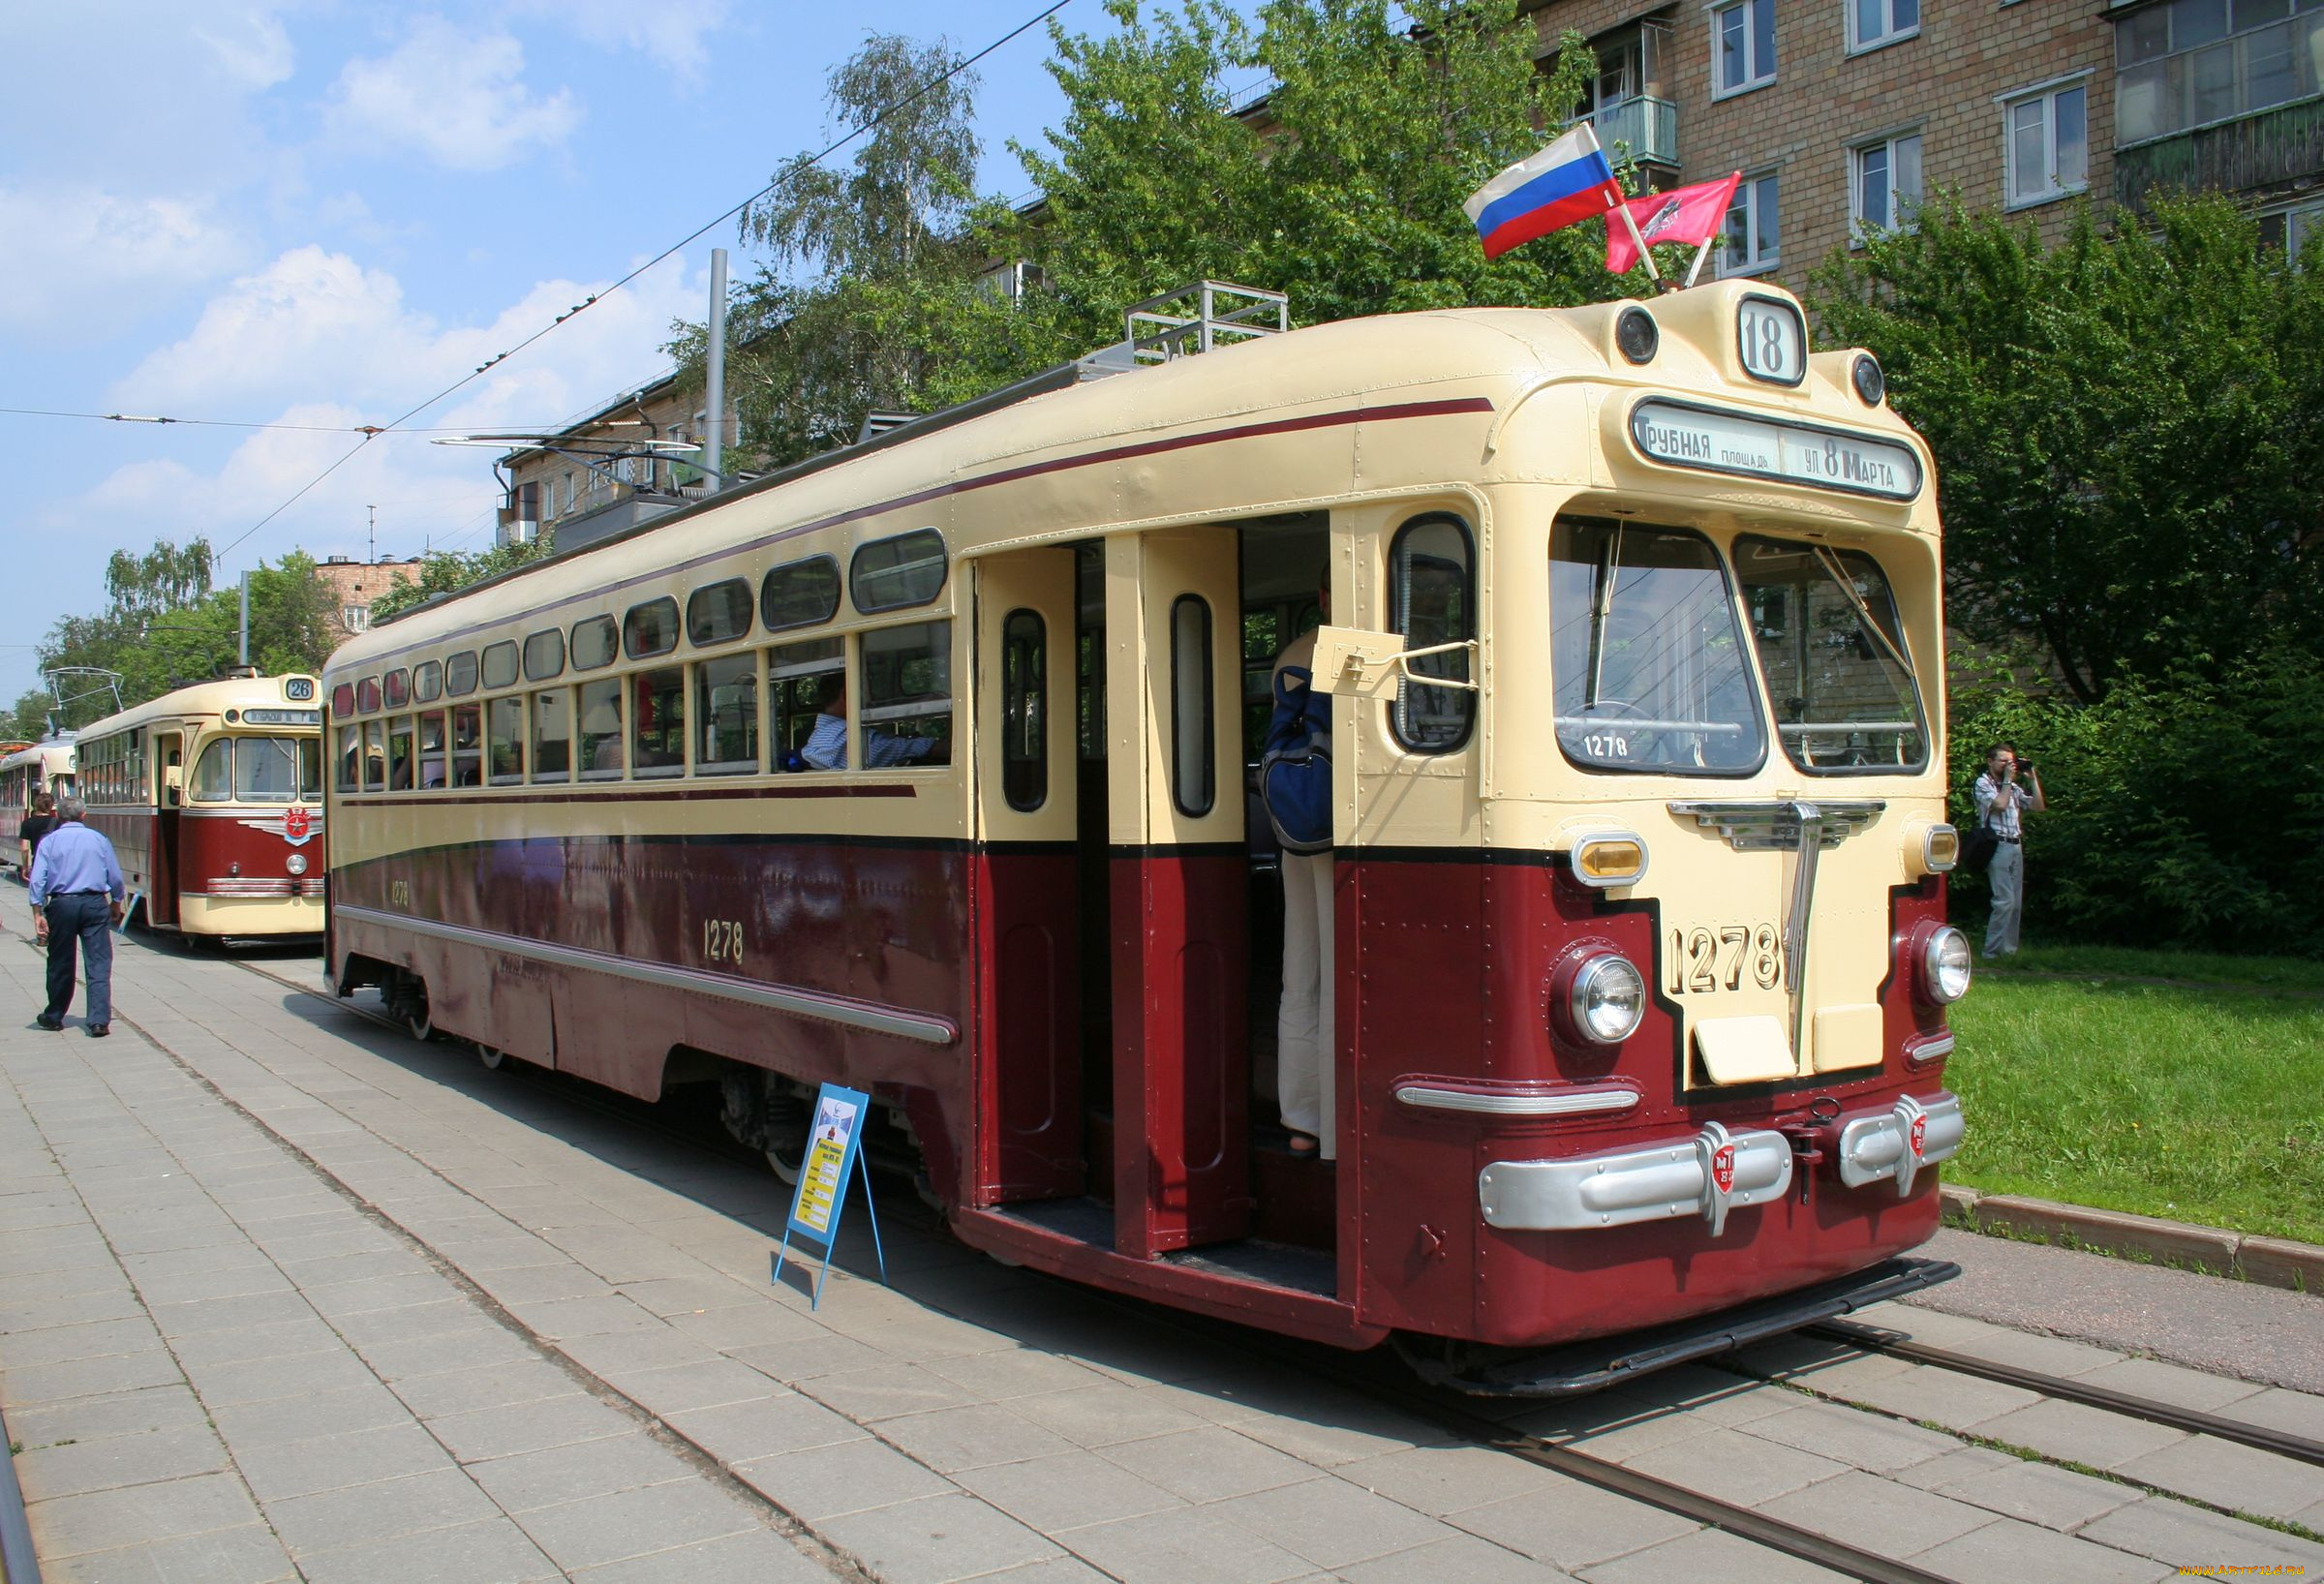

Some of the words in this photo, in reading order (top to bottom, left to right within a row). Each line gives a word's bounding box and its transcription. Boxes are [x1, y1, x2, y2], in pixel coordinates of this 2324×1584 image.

[1745, 311, 1784, 373] 18
[1721, 449, 1768, 470] ПЛОЩАДЬ
[1824, 438, 1839, 477] 8
[291, 682, 310, 697] 26
[1583, 735, 1629, 757] 1278
[391, 880, 409, 906] 1278
[704, 919, 743, 965] 1278
[1668, 923, 1780, 995] 1278
